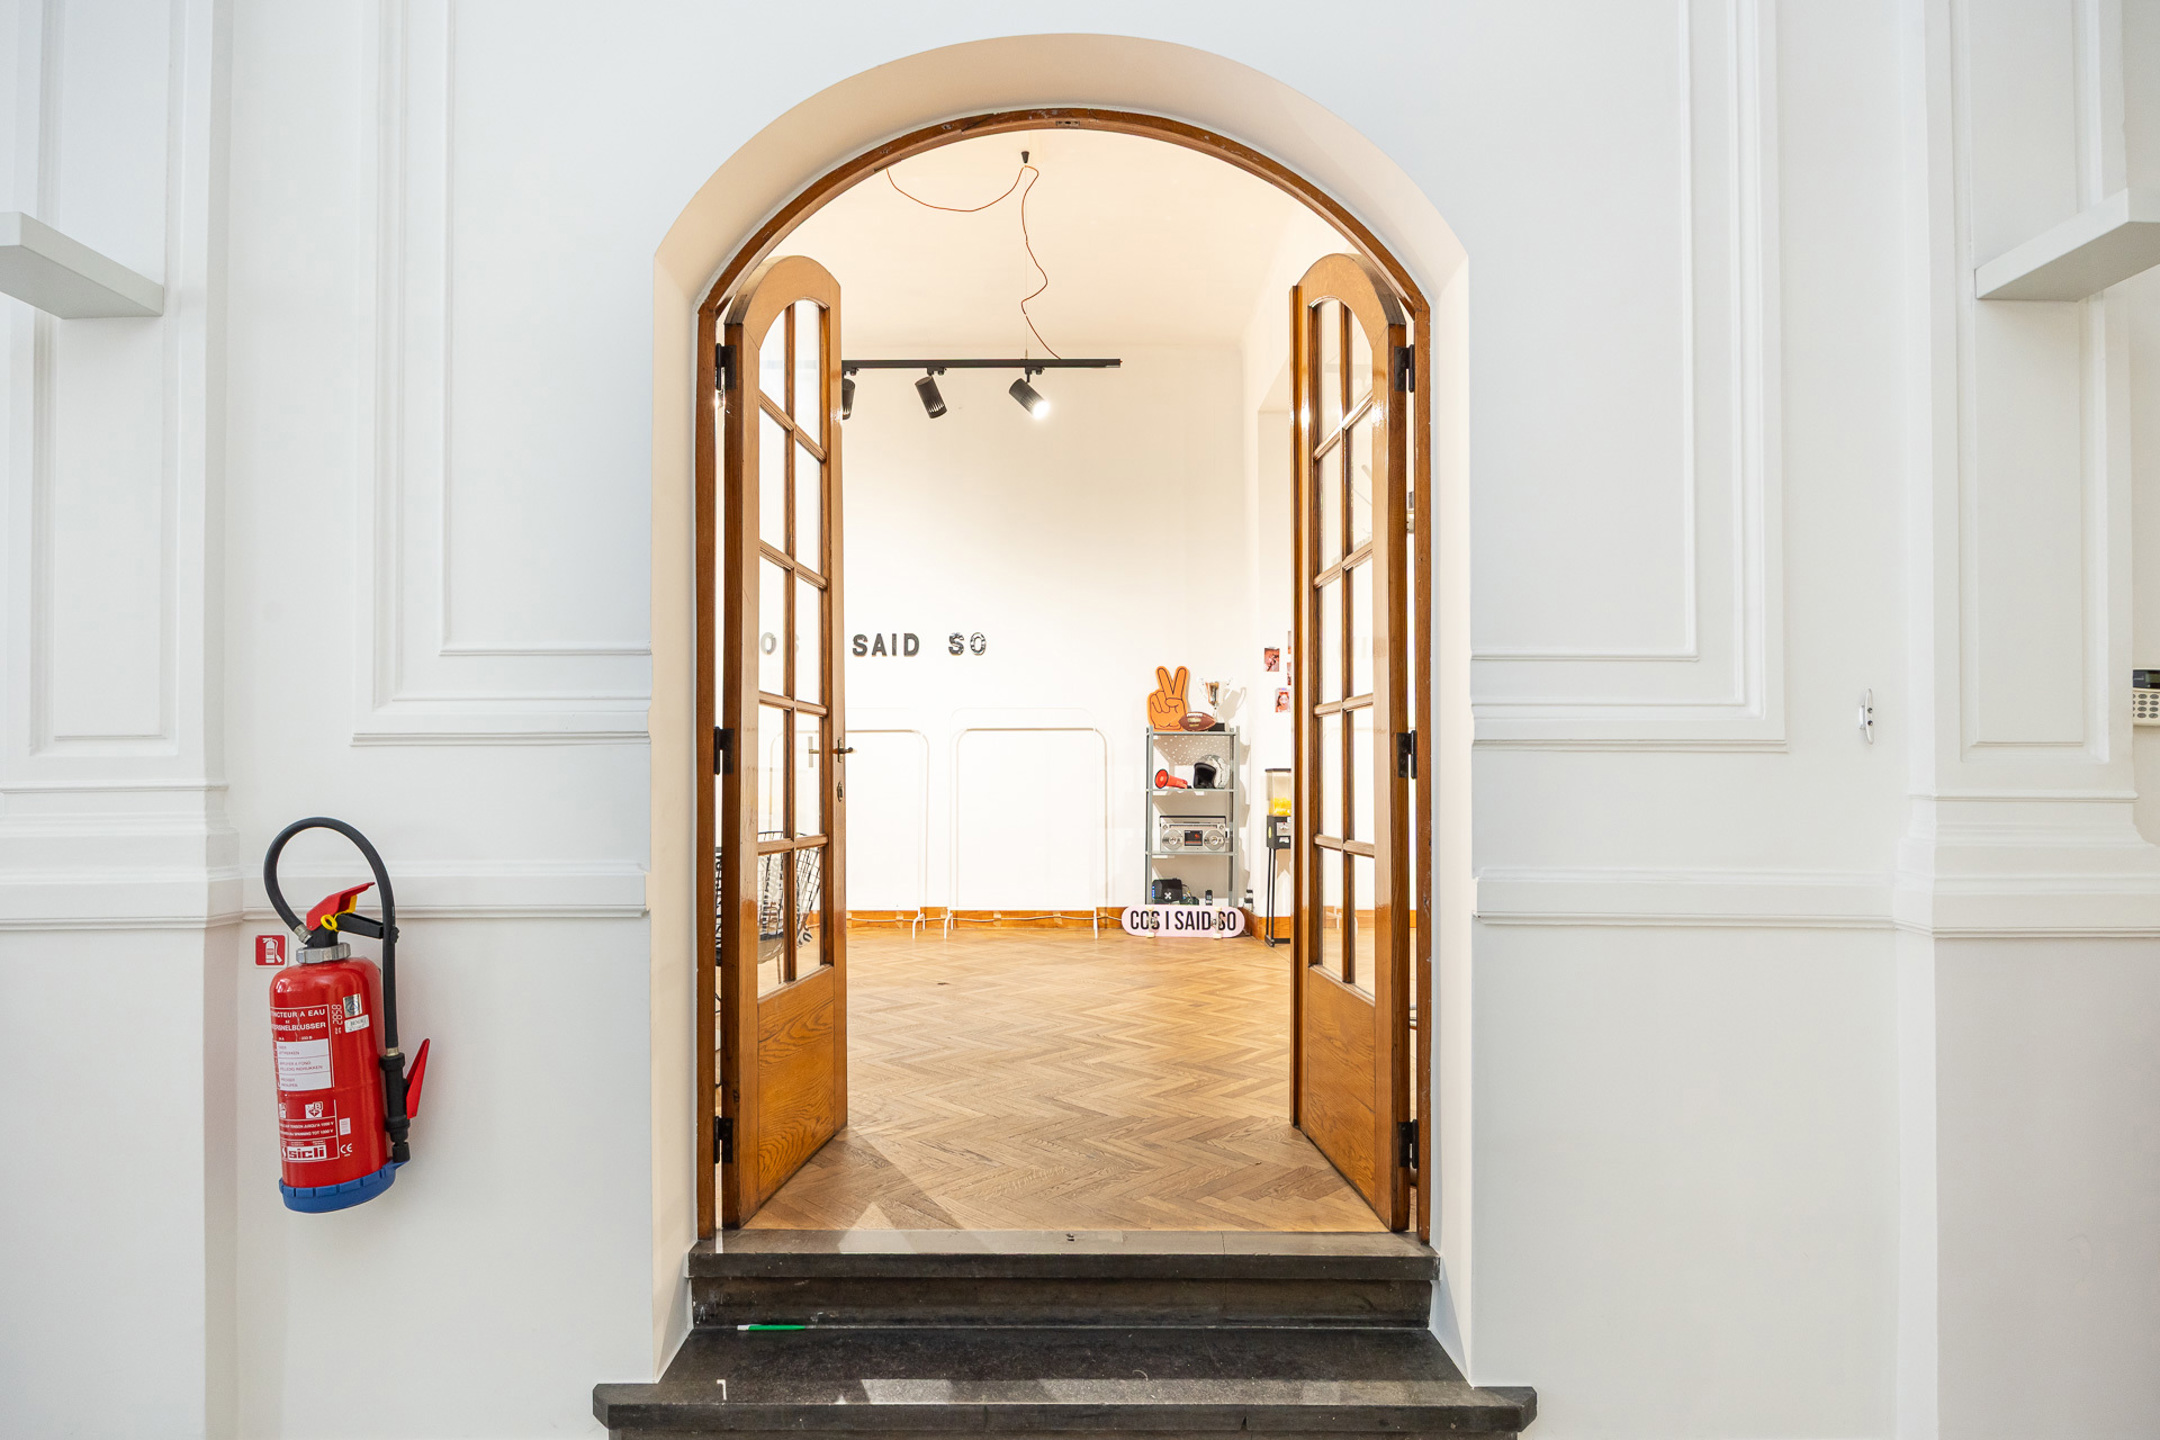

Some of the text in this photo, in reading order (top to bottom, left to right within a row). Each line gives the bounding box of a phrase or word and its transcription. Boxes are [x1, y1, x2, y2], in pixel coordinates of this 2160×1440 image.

[852, 632, 920, 657] SAID
[948, 631, 987, 656] SO
[1165, 910, 1170, 930] I
[1174, 911, 1211, 931] SAID
[1218, 911, 1236, 931] SO
[308, 1008, 326, 1017] EAU
[288, 1146, 325, 1159] sicli
